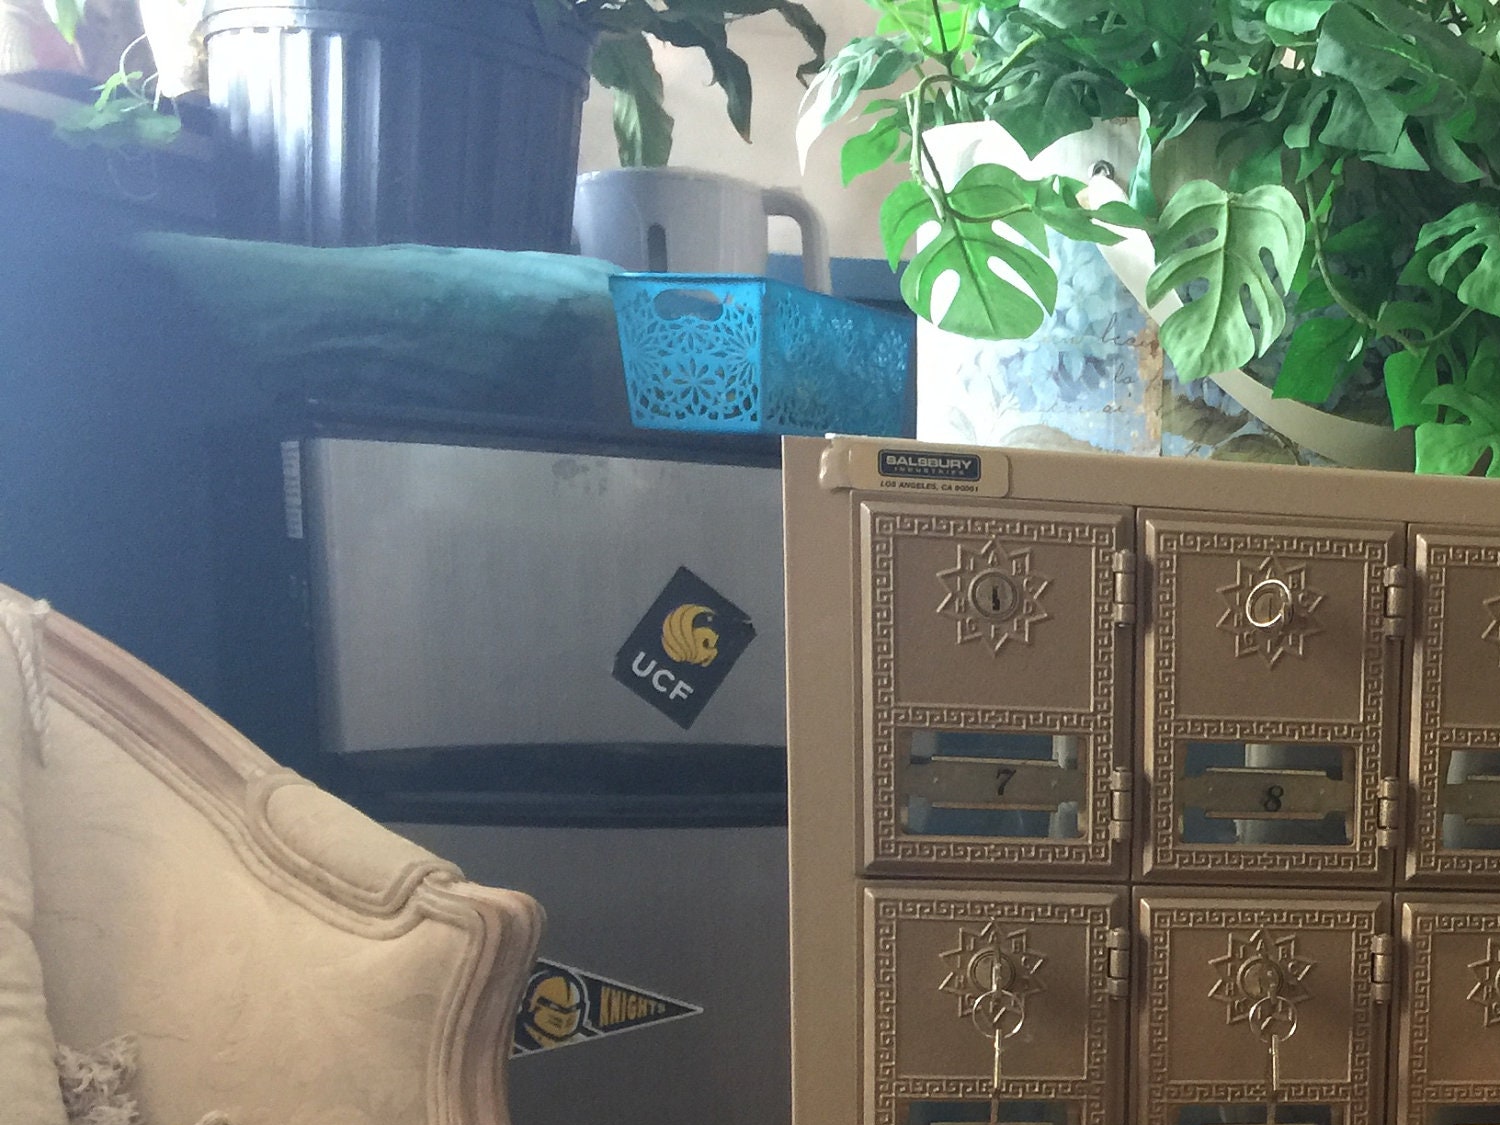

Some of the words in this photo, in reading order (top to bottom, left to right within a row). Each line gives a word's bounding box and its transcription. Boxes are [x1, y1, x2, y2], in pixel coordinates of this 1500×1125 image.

[886, 455, 972, 470] SALSBURY
[880, 480, 897, 488] LOS
[941, 484, 953, 492] CA
[632, 651, 694, 700] UCF
[995, 768, 1017, 796] 7
[1263, 784, 1284, 813] 8
[600, 986, 667, 1028] KNIGHTS
